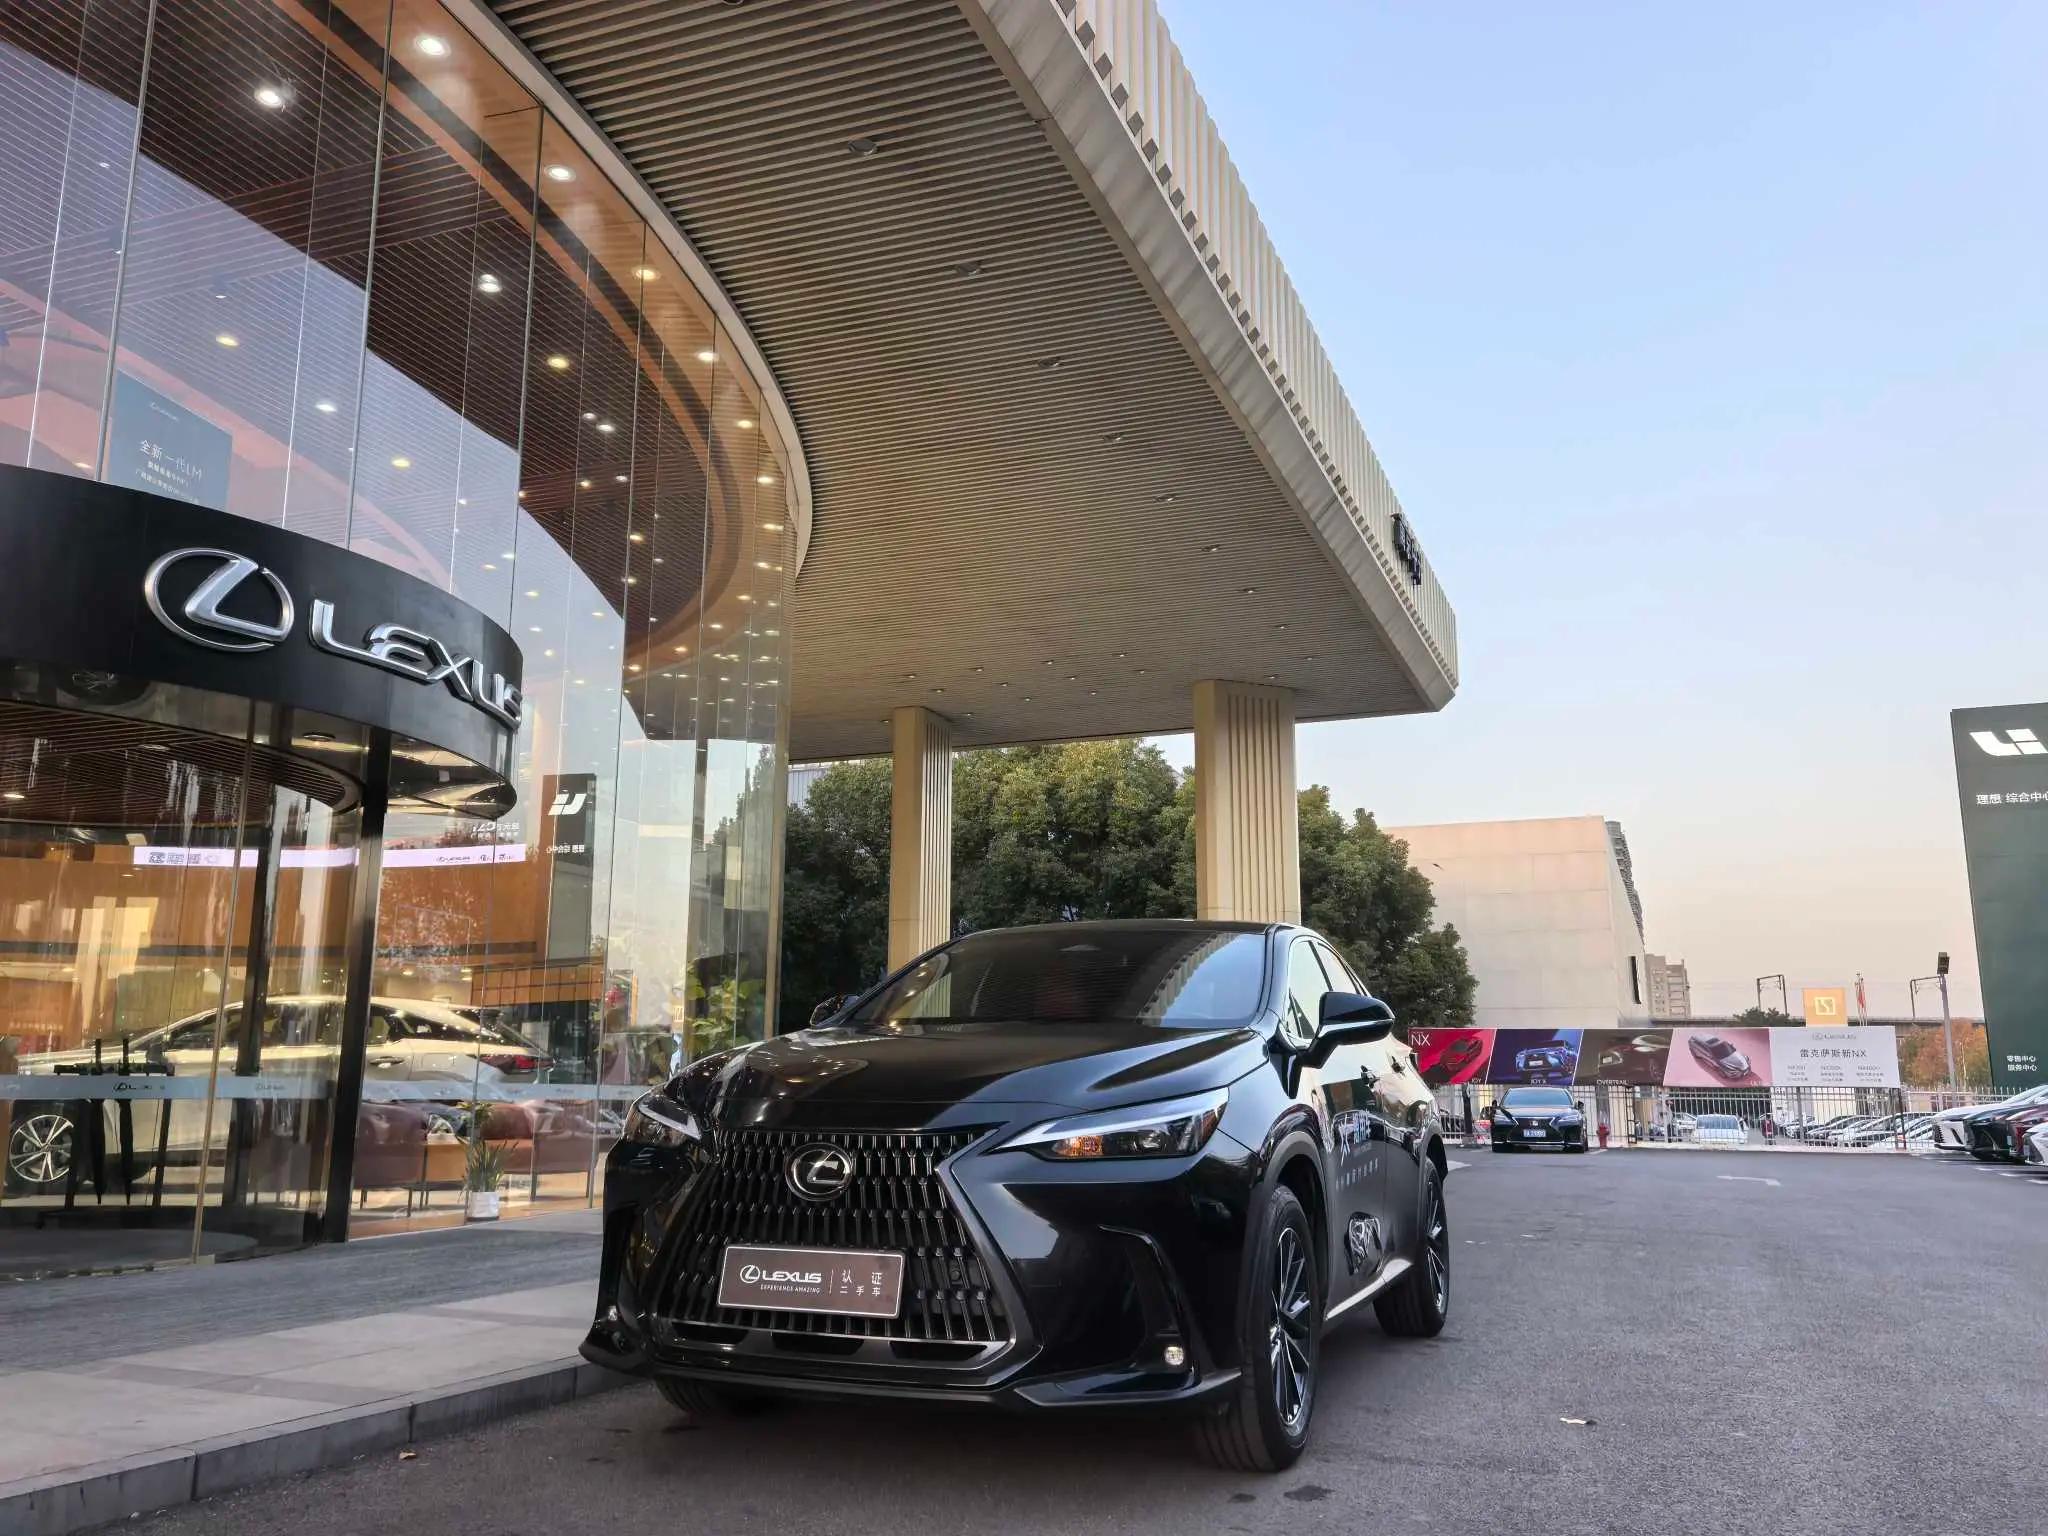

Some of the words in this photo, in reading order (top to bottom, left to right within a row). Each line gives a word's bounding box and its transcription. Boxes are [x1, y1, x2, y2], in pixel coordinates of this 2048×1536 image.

[309, 599, 523, 734] LEXUS
[1411, 1034, 1431, 1046] NX
[1800, 1049, 1866, 1058] 雷克萨斯新NX
[762, 1270, 822, 1284] LEXUS
[842, 1269, 883, 1285] 认证
[795, 1286, 821, 1294] AMAZING
[839, 1285, 882, 1297] 二手车
